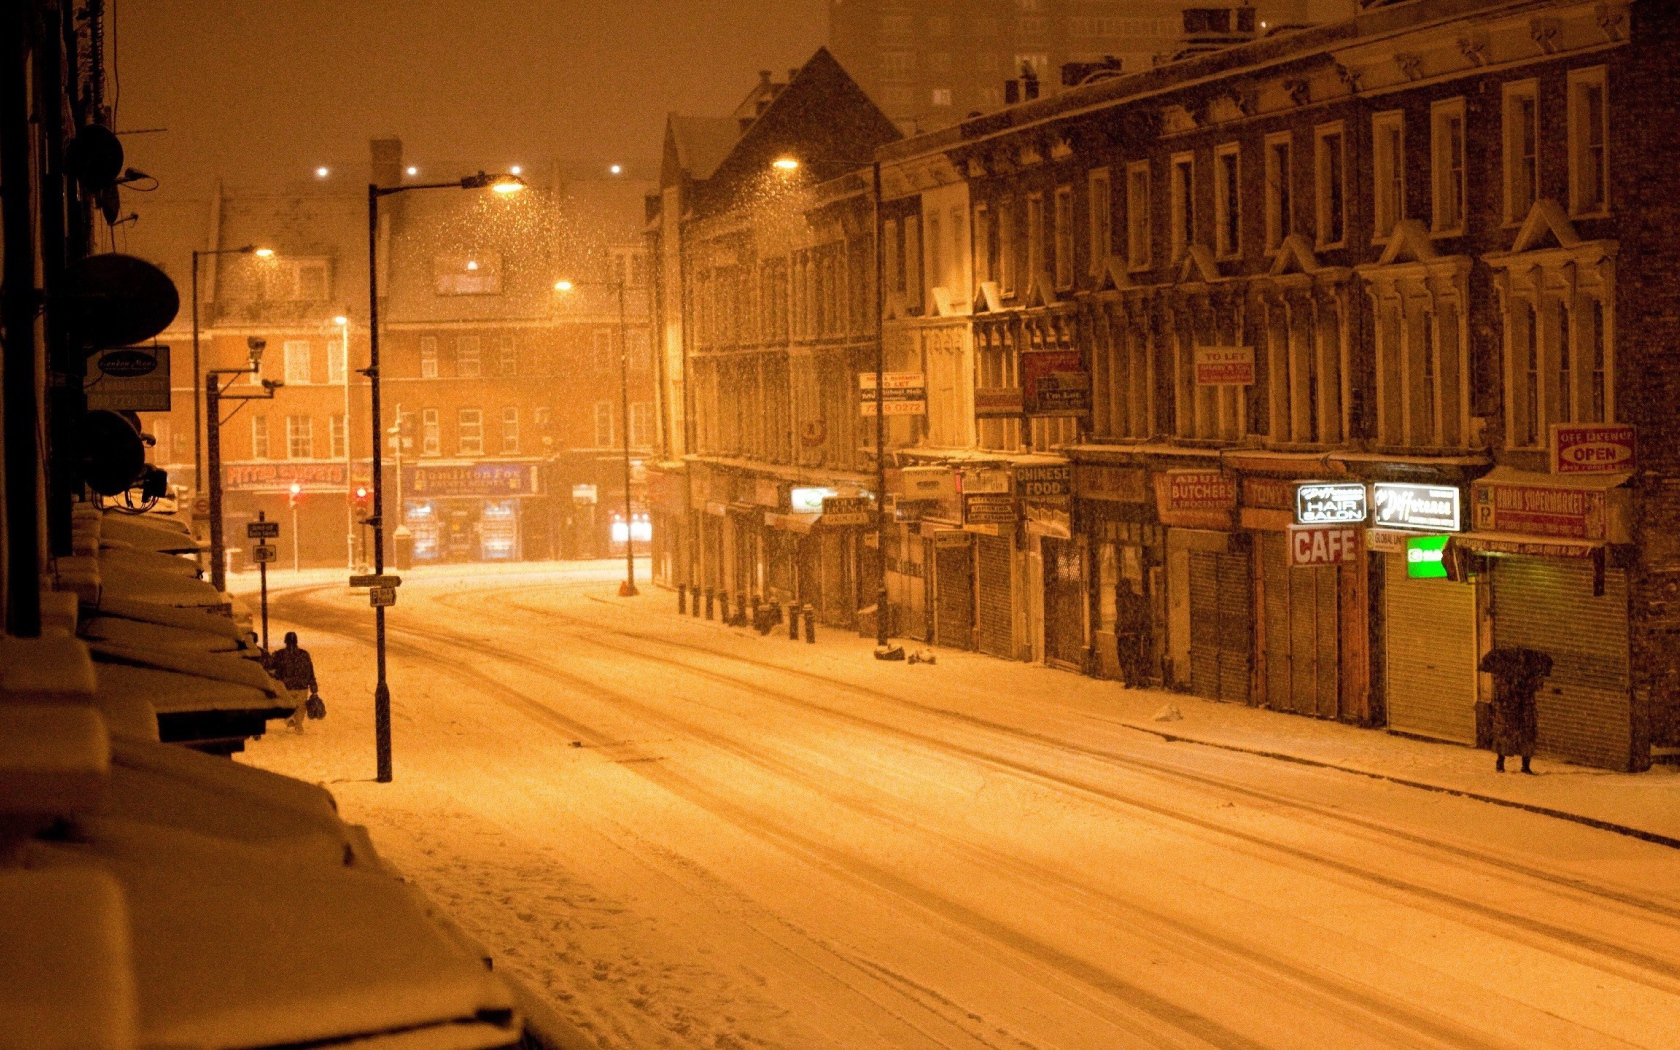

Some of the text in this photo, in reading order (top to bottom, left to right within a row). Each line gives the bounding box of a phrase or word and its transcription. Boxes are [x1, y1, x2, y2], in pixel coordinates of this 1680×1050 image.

[1224, 352, 1246, 360] LET
[1560, 433, 1582, 443] OFF
[1573, 447, 1616, 462] OPEN
[1017, 467, 1070, 481] CHINESE
[1026, 481, 1061, 495] FOOD
[1172, 485, 1234, 499] BUTCHERS
[1307, 500, 1357, 512] HAIR
[1524, 490, 1583, 515] SUPERMARKET
[1303, 510, 1362, 521] SALON
[1375, 532, 1393, 545] GLOBAL
[1294, 530, 1356, 563] CAFE
